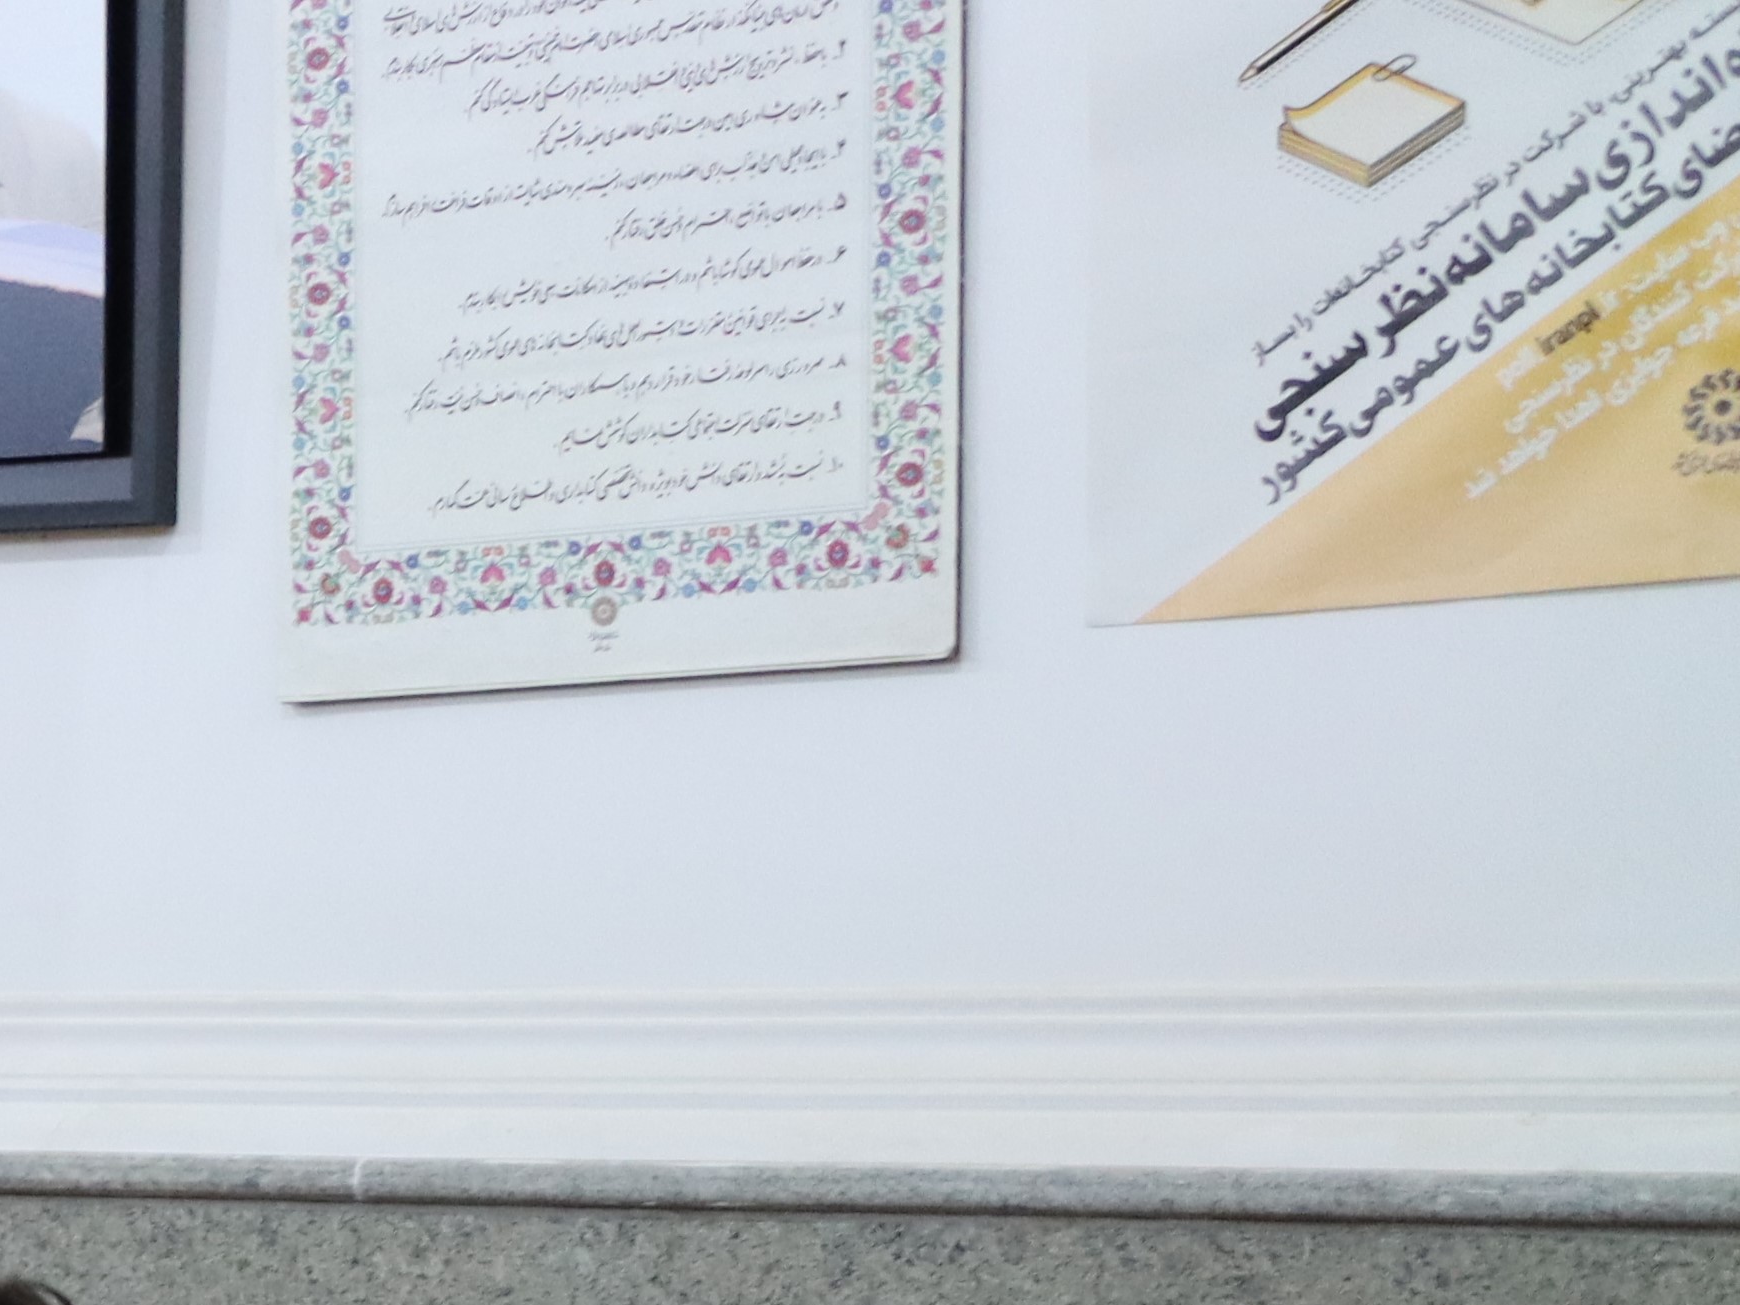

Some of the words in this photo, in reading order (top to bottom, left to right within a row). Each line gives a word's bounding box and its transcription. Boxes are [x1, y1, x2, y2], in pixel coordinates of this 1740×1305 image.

[1584, 98, 1605, 117] با
[1523, 113, 1586, 162] شرکت
[1505, 161, 1520, 185] در
[1445, 169, 1589, 285] سامانه
[1293, 313, 1312, 331] را
[1253, 325, 1296, 365] بساز
[1348, 336, 1459, 437] عمومی
[1261, 410, 1349, 504] کشور
